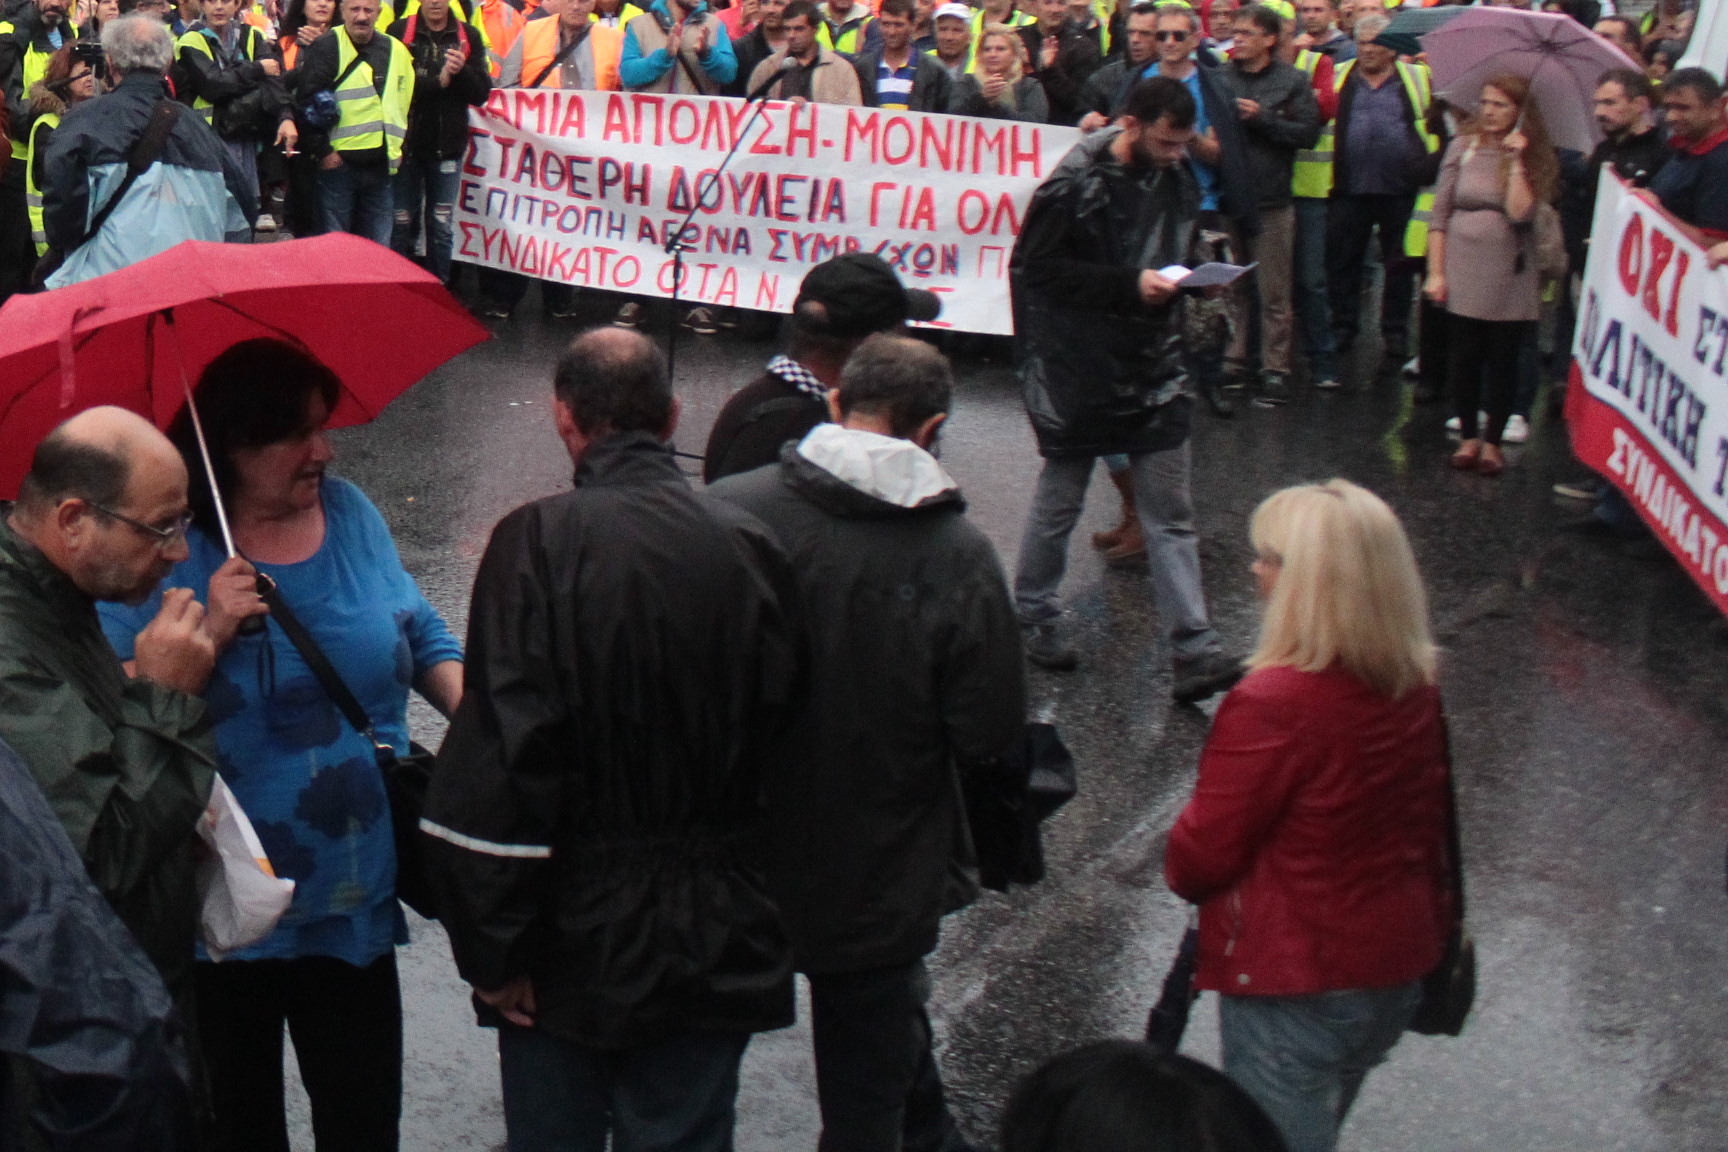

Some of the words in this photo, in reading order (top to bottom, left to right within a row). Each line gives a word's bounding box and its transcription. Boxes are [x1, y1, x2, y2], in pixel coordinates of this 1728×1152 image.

[846, 111, 1043, 178] ΜΟΝΙΜΗ
[459, 179, 626, 241] ΕΠΙΤΡΟΠΗ
[463, 127, 653, 206] ΣΤΑΘΕΡΗ
[668, 165, 848, 224] ΔΟΥΛΕΙΑ
[870, 182, 937, 232] ΓΙΑ
[459, 220, 642, 289] ΣΥΝΔΙΚΑΤΟ
